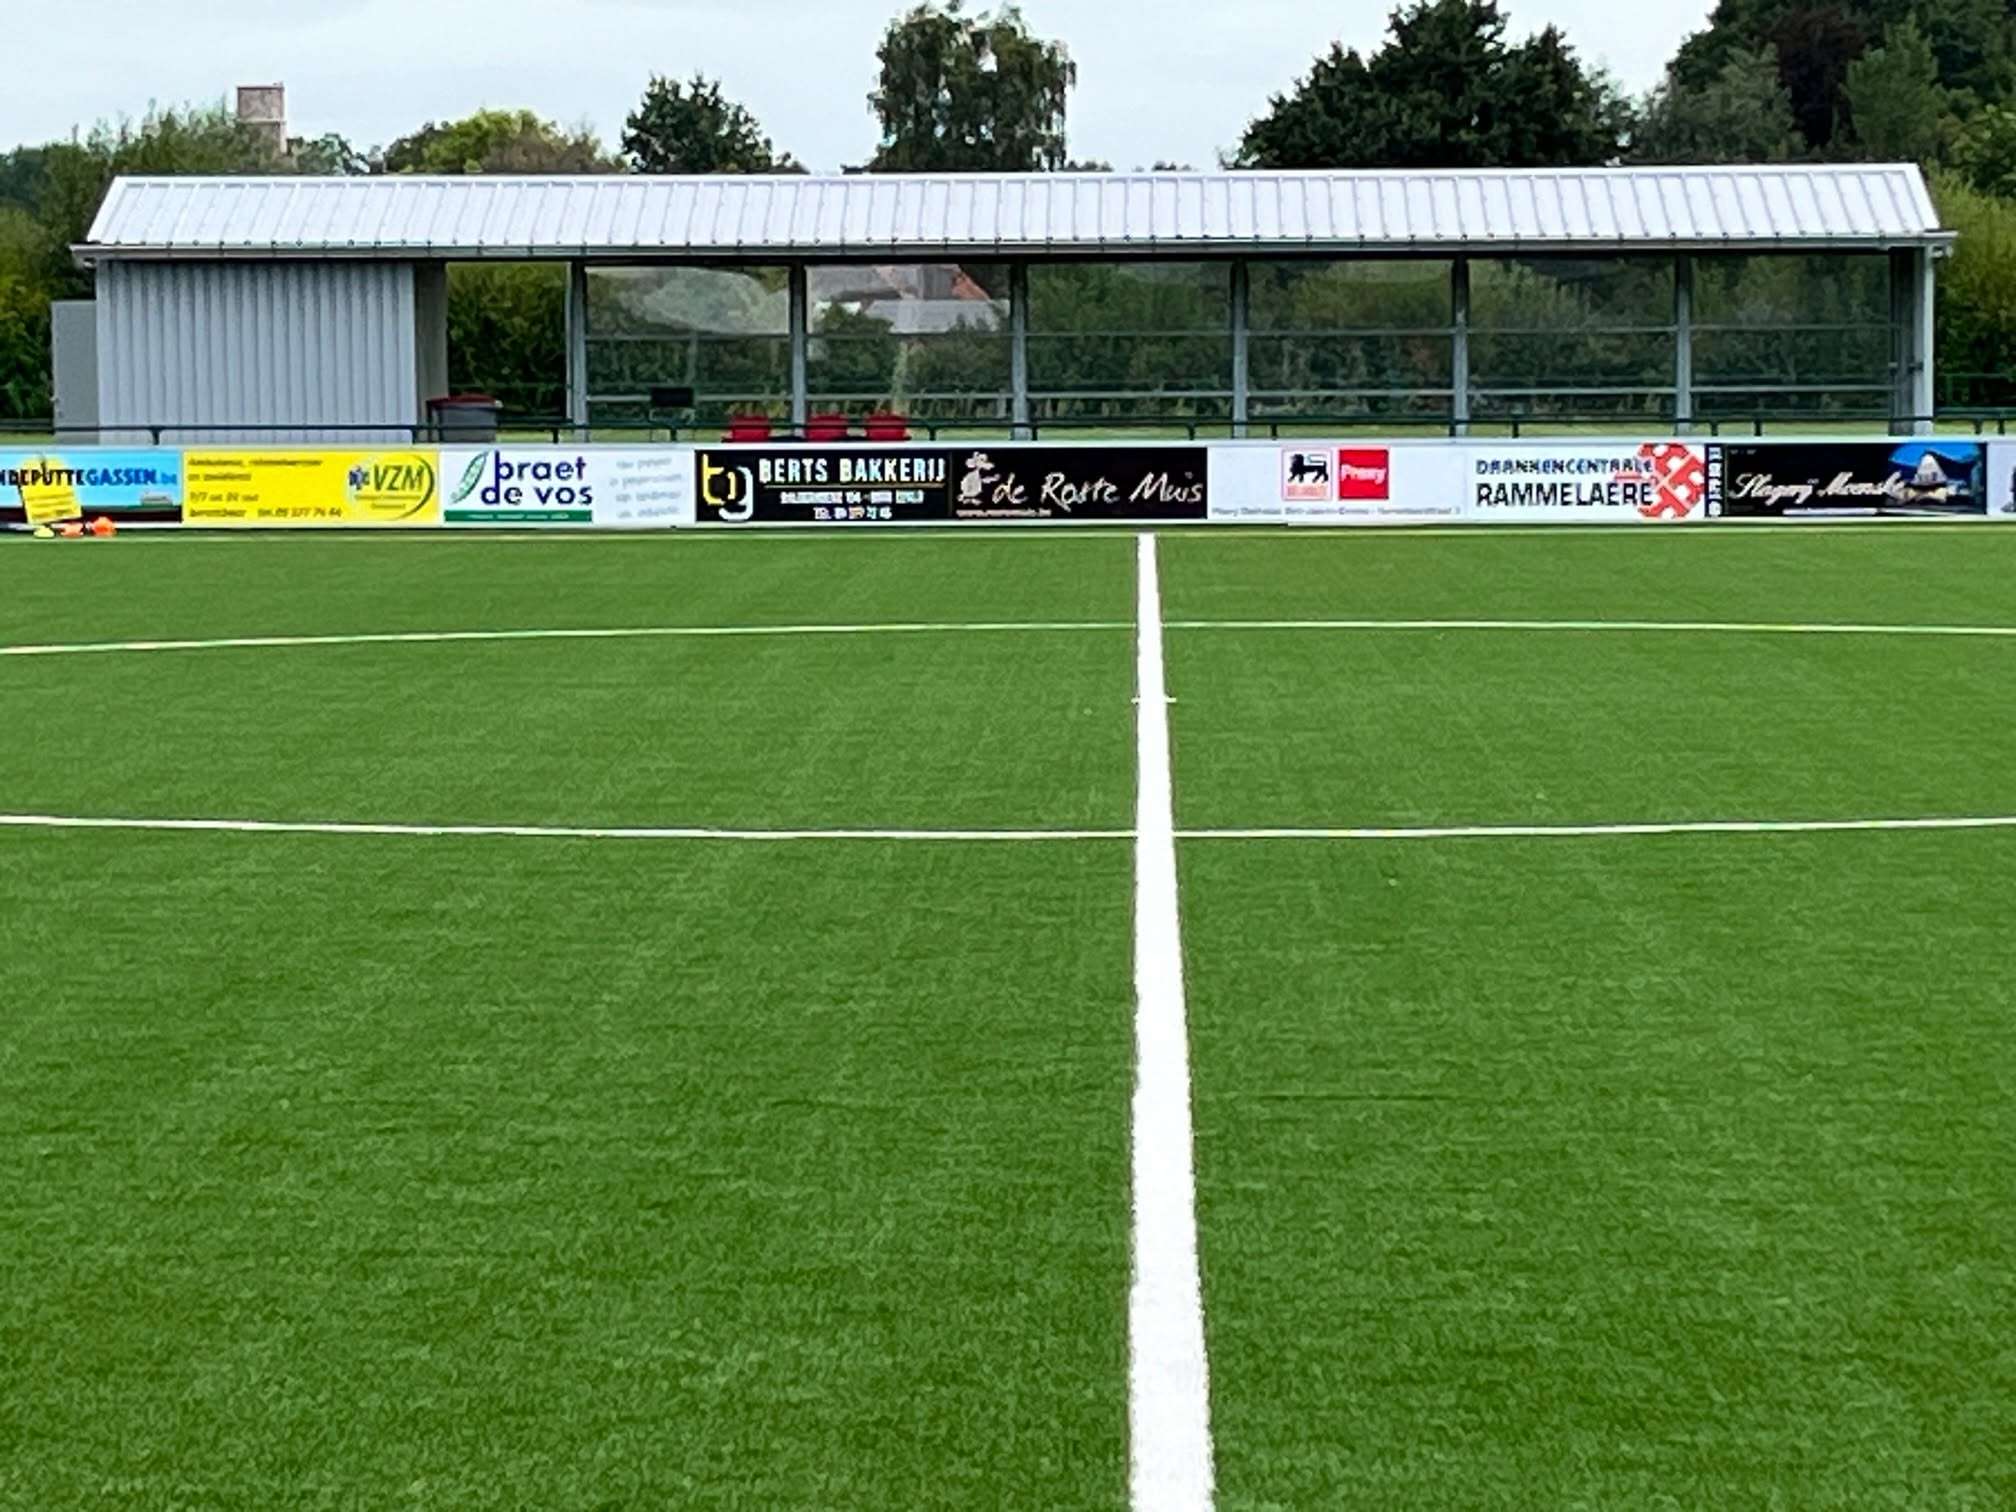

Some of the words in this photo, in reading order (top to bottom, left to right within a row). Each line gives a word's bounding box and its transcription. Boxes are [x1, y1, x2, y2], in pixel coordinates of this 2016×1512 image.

[374, 464, 425, 491] VZM
[495, 450, 587, 480] braet
[759, 458, 828, 483] BERTS
[839, 457, 945, 483] BAKKERIJ
[1476, 457, 1653, 475] DRANKENCENTRALE
[480, 482, 523, 505] de
[534, 486, 593, 505] vos
[992, 472, 1029, 505] de
[1476, 483, 1653, 506] RAMMELAERE
